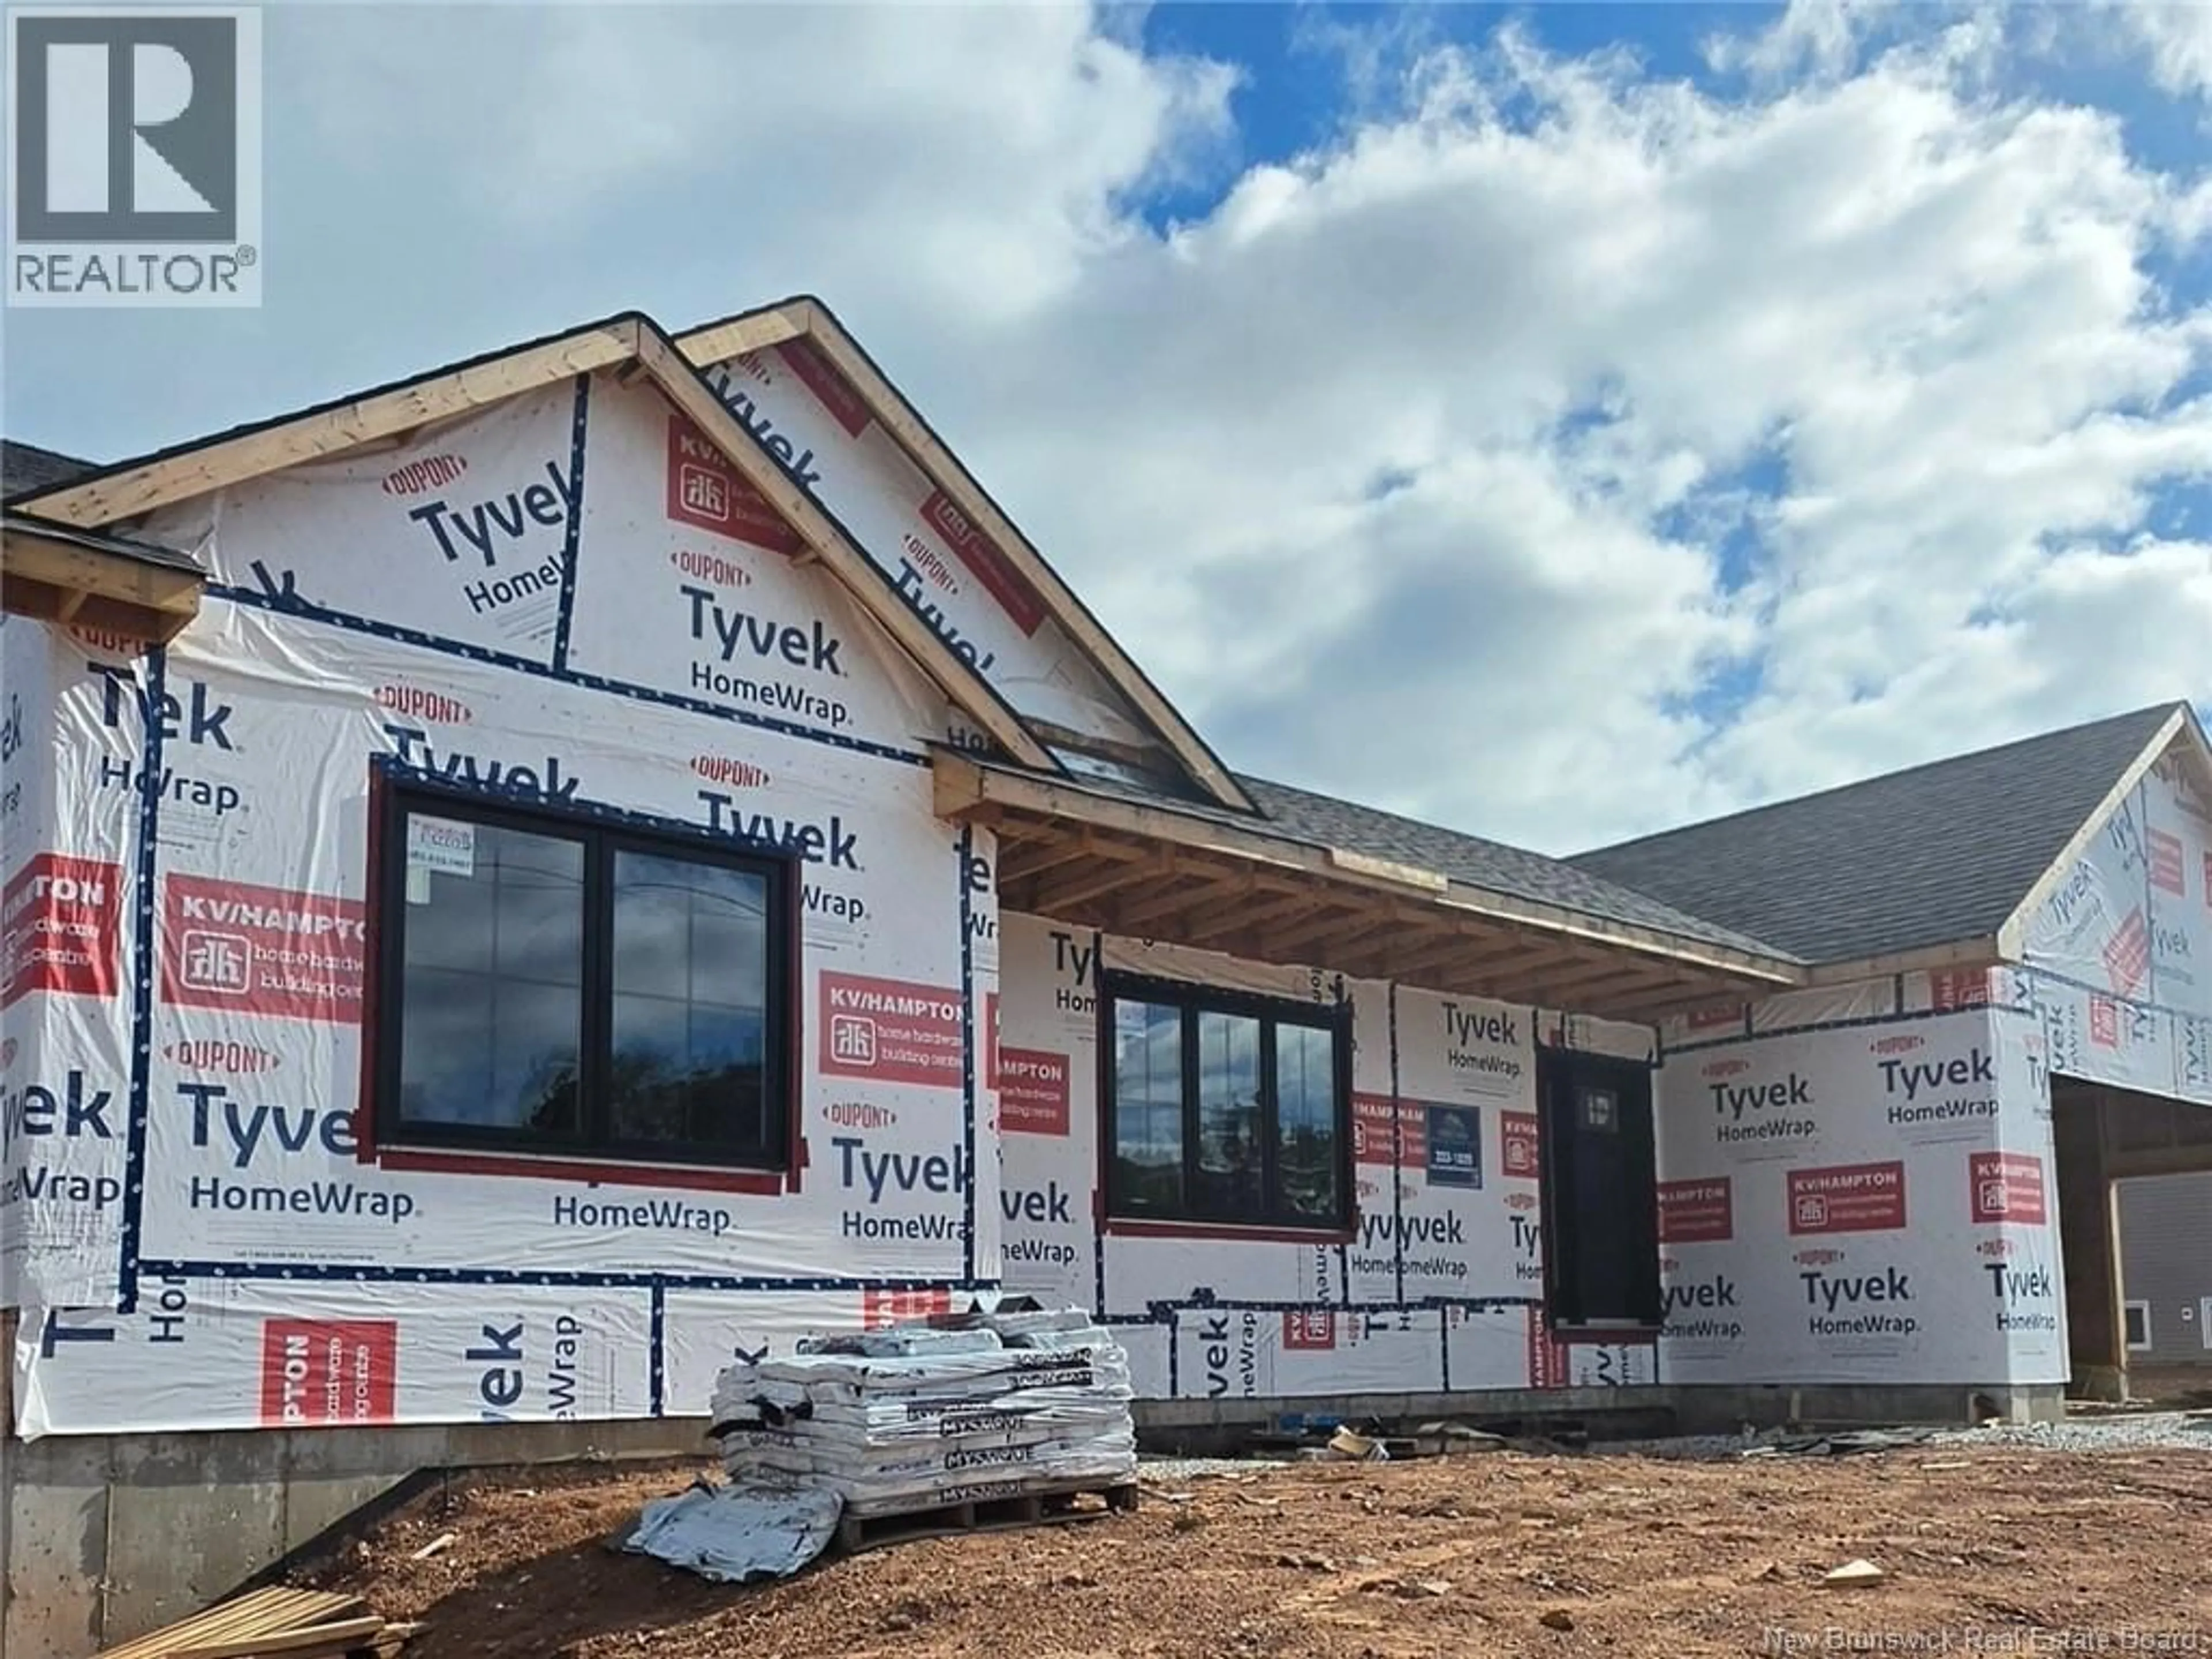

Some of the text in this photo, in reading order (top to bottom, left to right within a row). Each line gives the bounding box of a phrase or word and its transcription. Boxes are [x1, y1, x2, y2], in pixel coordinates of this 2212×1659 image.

[387, 453, 465, 497] DUPONT
[680, 551, 744, 588] DUPONT
[680, 585, 841, 675] Tyvek
[384, 685, 461, 724] DUPONT
[692, 661, 847, 726] HomeWrap
[697, 756, 762, 787] DUPONT
[698, 791, 857, 870] Tyvek
[1442, 1002, 1517, 1046] Tyvek
[179, 1039, 271, 1073] DUPONT
[1448, 1050, 1520, 1078] HomeWrap
[1878, 1048, 1993, 1100] Tyvek
[831, 1102, 890, 1129] DUPONT
[1709, 1073, 1809, 1120] Tyvek
[1888, 1099, 1999, 1124] HomeWrap
[1717, 1120, 1815, 1142] HomeWrap
[191, 1176, 414, 1224] HomeWrap
[1794, 1172, 1898, 1192] KV/HAMPTON
[554, 1196, 731, 1236] HomeWrap
[1800, 1267, 1909, 1312] Tyvek
[1809, 1316, 1916, 1336] HomeWrap
